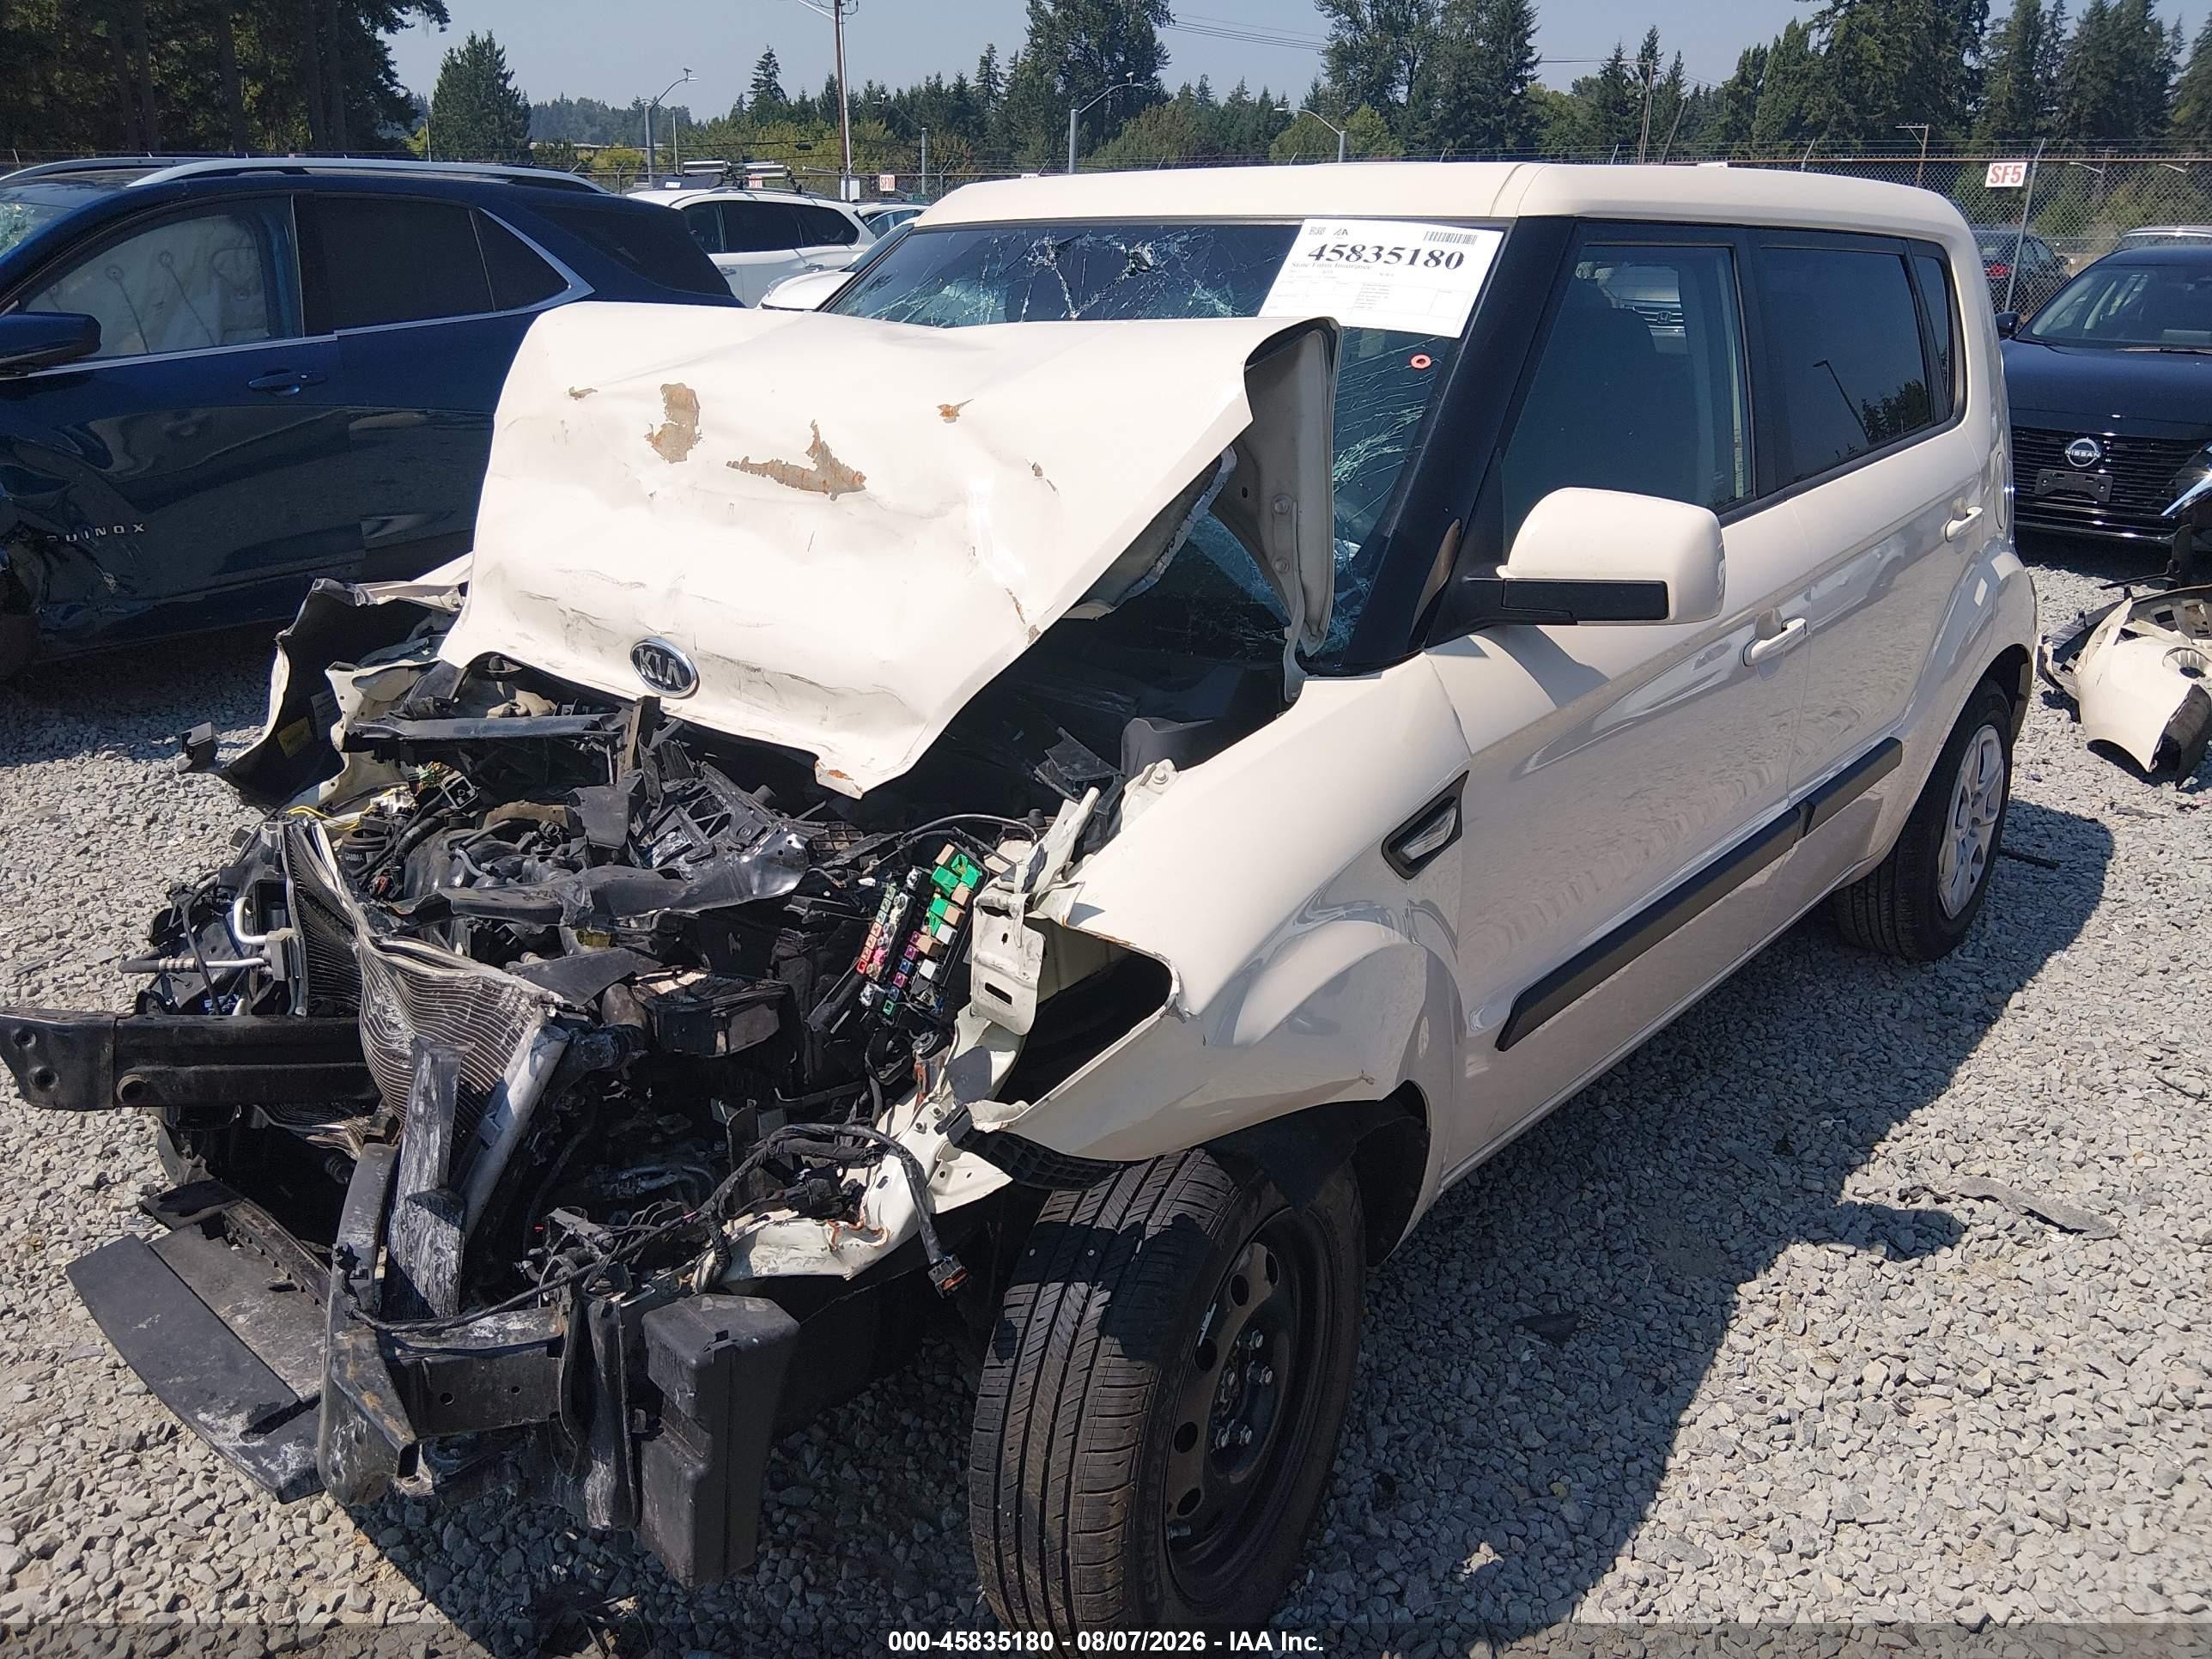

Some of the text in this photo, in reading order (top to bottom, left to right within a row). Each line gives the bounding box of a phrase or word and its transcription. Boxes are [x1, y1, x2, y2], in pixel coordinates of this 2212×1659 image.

[881, 177, 894, 189] SF10
[1990, 164, 2022, 184] SF5
[1307, 243, 1465, 270] 45835180
[2064, 449, 2101, 459] NISSAN
[637, 647, 684, 688] KIA
